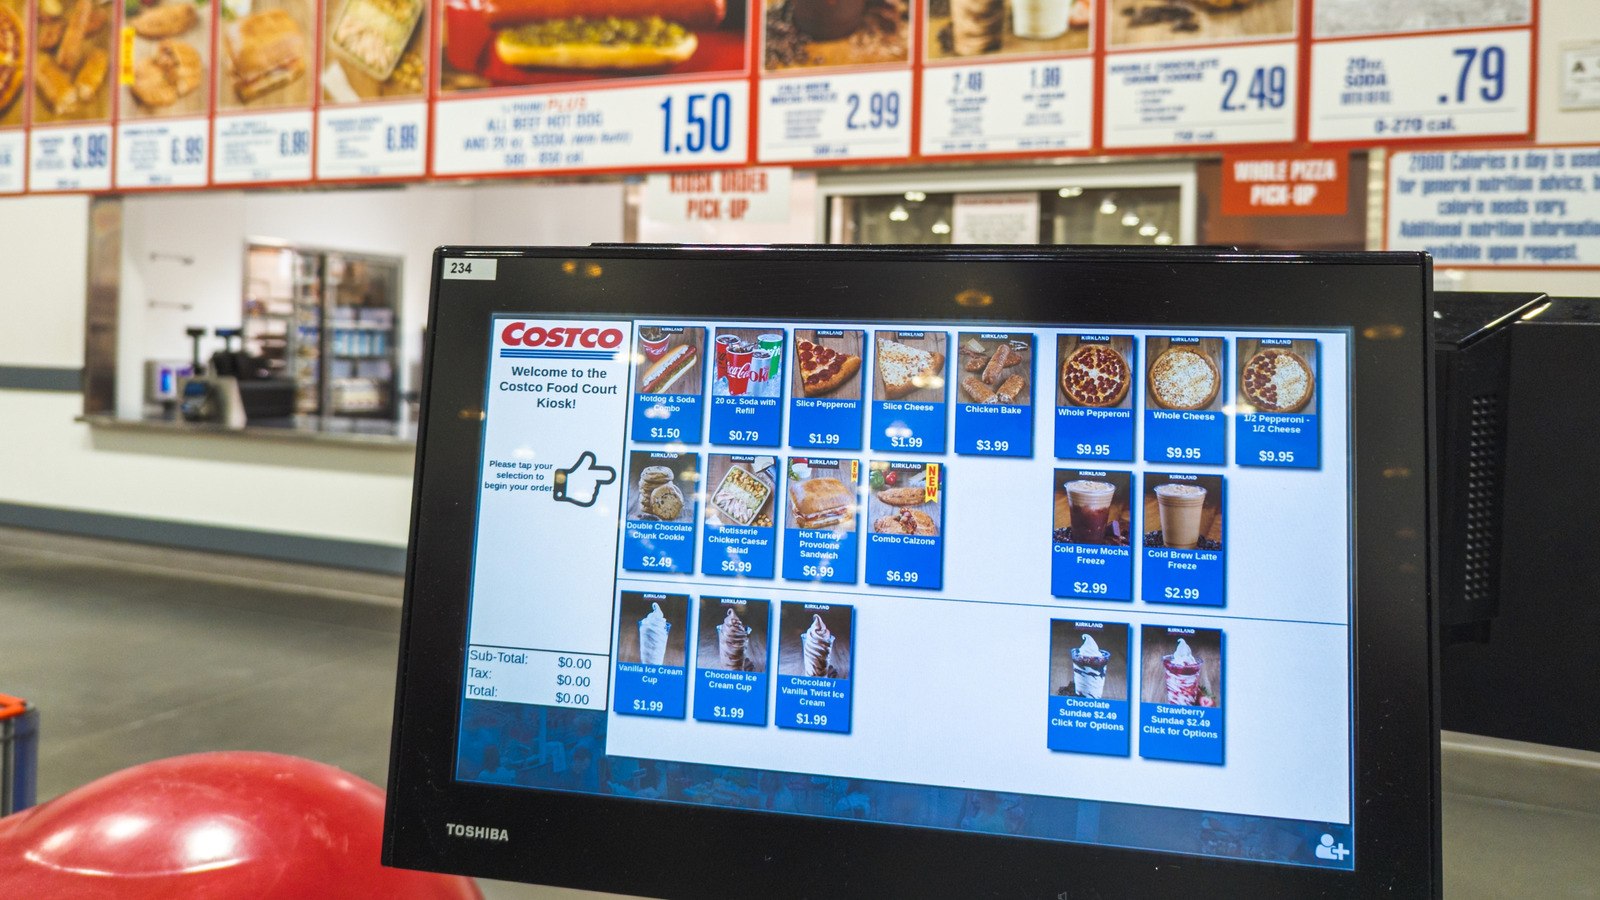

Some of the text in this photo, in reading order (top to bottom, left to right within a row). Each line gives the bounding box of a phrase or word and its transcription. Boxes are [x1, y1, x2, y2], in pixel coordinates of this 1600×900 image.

[1438, 46, 1506, 104] .79
[1344, 73, 1387, 89] SODA
[1220, 66, 1287, 111] 2.49
[846, 91, 900, 131] 2.99
[660, 92, 732, 154] 1.50
[1450, 153, 1506, 169] Calories
[1525, 154, 1547, 171] day
[1234, 158, 1337, 181] WHOLE PIZZA
[1250, 184, 1317, 206] PICK-UP
[450, 262, 472, 274] 234
[512, 367, 607, 378] Welcome to the
[500, 381, 617, 394] Costco Food Court
[537, 398, 576, 408] Kiosk!
[640, 395, 667, 404] Hotdog
[796, 400, 856, 410] Slice Pepperoni
[654, 404, 680, 412] Combo
[883, 402, 902, 410] Slice
[966, 406, 999, 414] Chicken
[1086, 410, 1130, 419] Pepperoni
[1153, 411, 1215, 421] Whole Cheese
[1244, 414, 1304, 424] 1/2 Pepperoni
[651, 428, 680, 438] $1.50
[1252, 425, 1301, 433] 1/2 Cheese
[729, 430, 759, 441] $0.79
[809, 433, 839, 444] $1.99
[891, 437, 922, 448] $1.99
[977, 440, 1008, 451] $3.99
[1077, 444, 1110, 455] $9.95
[1167, 447, 1201, 459] $9.95
[1259, 451, 1294, 462] $9.95
[489, 460, 553, 471] Please tap your
[497, 472, 533, 480] selection
[926, 465, 937, 497] NEW
[485, 482, 554, 492] begin your order.
[627, 522, 692, 532] Double Chocolate
[719, 527, 758, 535] Rotisserie
[659, 533, 685, 541] Cookie
[709, 536, 768, 546] Chicken Caesar
[815, 532, 842, 541] Turkey
[872, 535, 935, 545] Combo Calzone
[727, 546, 748, 554] Salad
[800, 541, 839, 550] Provolone
[1054, 545, 1128, 556] Cold Brew Mocha
[800, 551, 838, 559] Sandwich
[1148, 550, 1217, 561] Cold Brew Latte
[642, 556, 672, 567] $2.49
[722, 561, 751, 572] $6.99
[1077, 557, 1105, 565] Freeze
[1168, 562, 1197, 570] Freeze
[803, 565, 834, 577] $6.99
[886, 570, 918, 582] $6.99
[1074, 582, 1107, 594] $2.99
[1165, 587, 1199, 599] $2.99
[470, 649, 592, 669] Sub-Total: $0.00
[619, 664, 643, 673] Vanilla
[658, 667, 682, 676] Cream
[705, 671, 743, 680] Chocolate
[469, 667, 590, 688] Tax: $0.00
[642, 676, 658, 684] Cup
[791, 677, 831, 688] Chocolate
[709, 681, 752, 692] Cream Cup
[468, 685, 589, 705] Total: $0.00
[782, 687, 844, 699] Vanilla Twist Ice
[633, 699, 663, 712] $1.99
[799, 698, 825, 707] Cream
[1066, 699, 1110, 709] Chocolate
[714, 706, 744, 718] $1.99
[1059, 709, 1117, 720] Sundae $2.49
[1157, 705, 1205, 717] Strawberry
[796, 713, 827, 726] $1.99
[1052, 719, 1124, 731] Click for Options
[1151, 715, 1210, 727] Sundae $2.49
[1143, 726, 1218, 739] Click for Options
[446, 823, 509, 841] TOSHIBA
